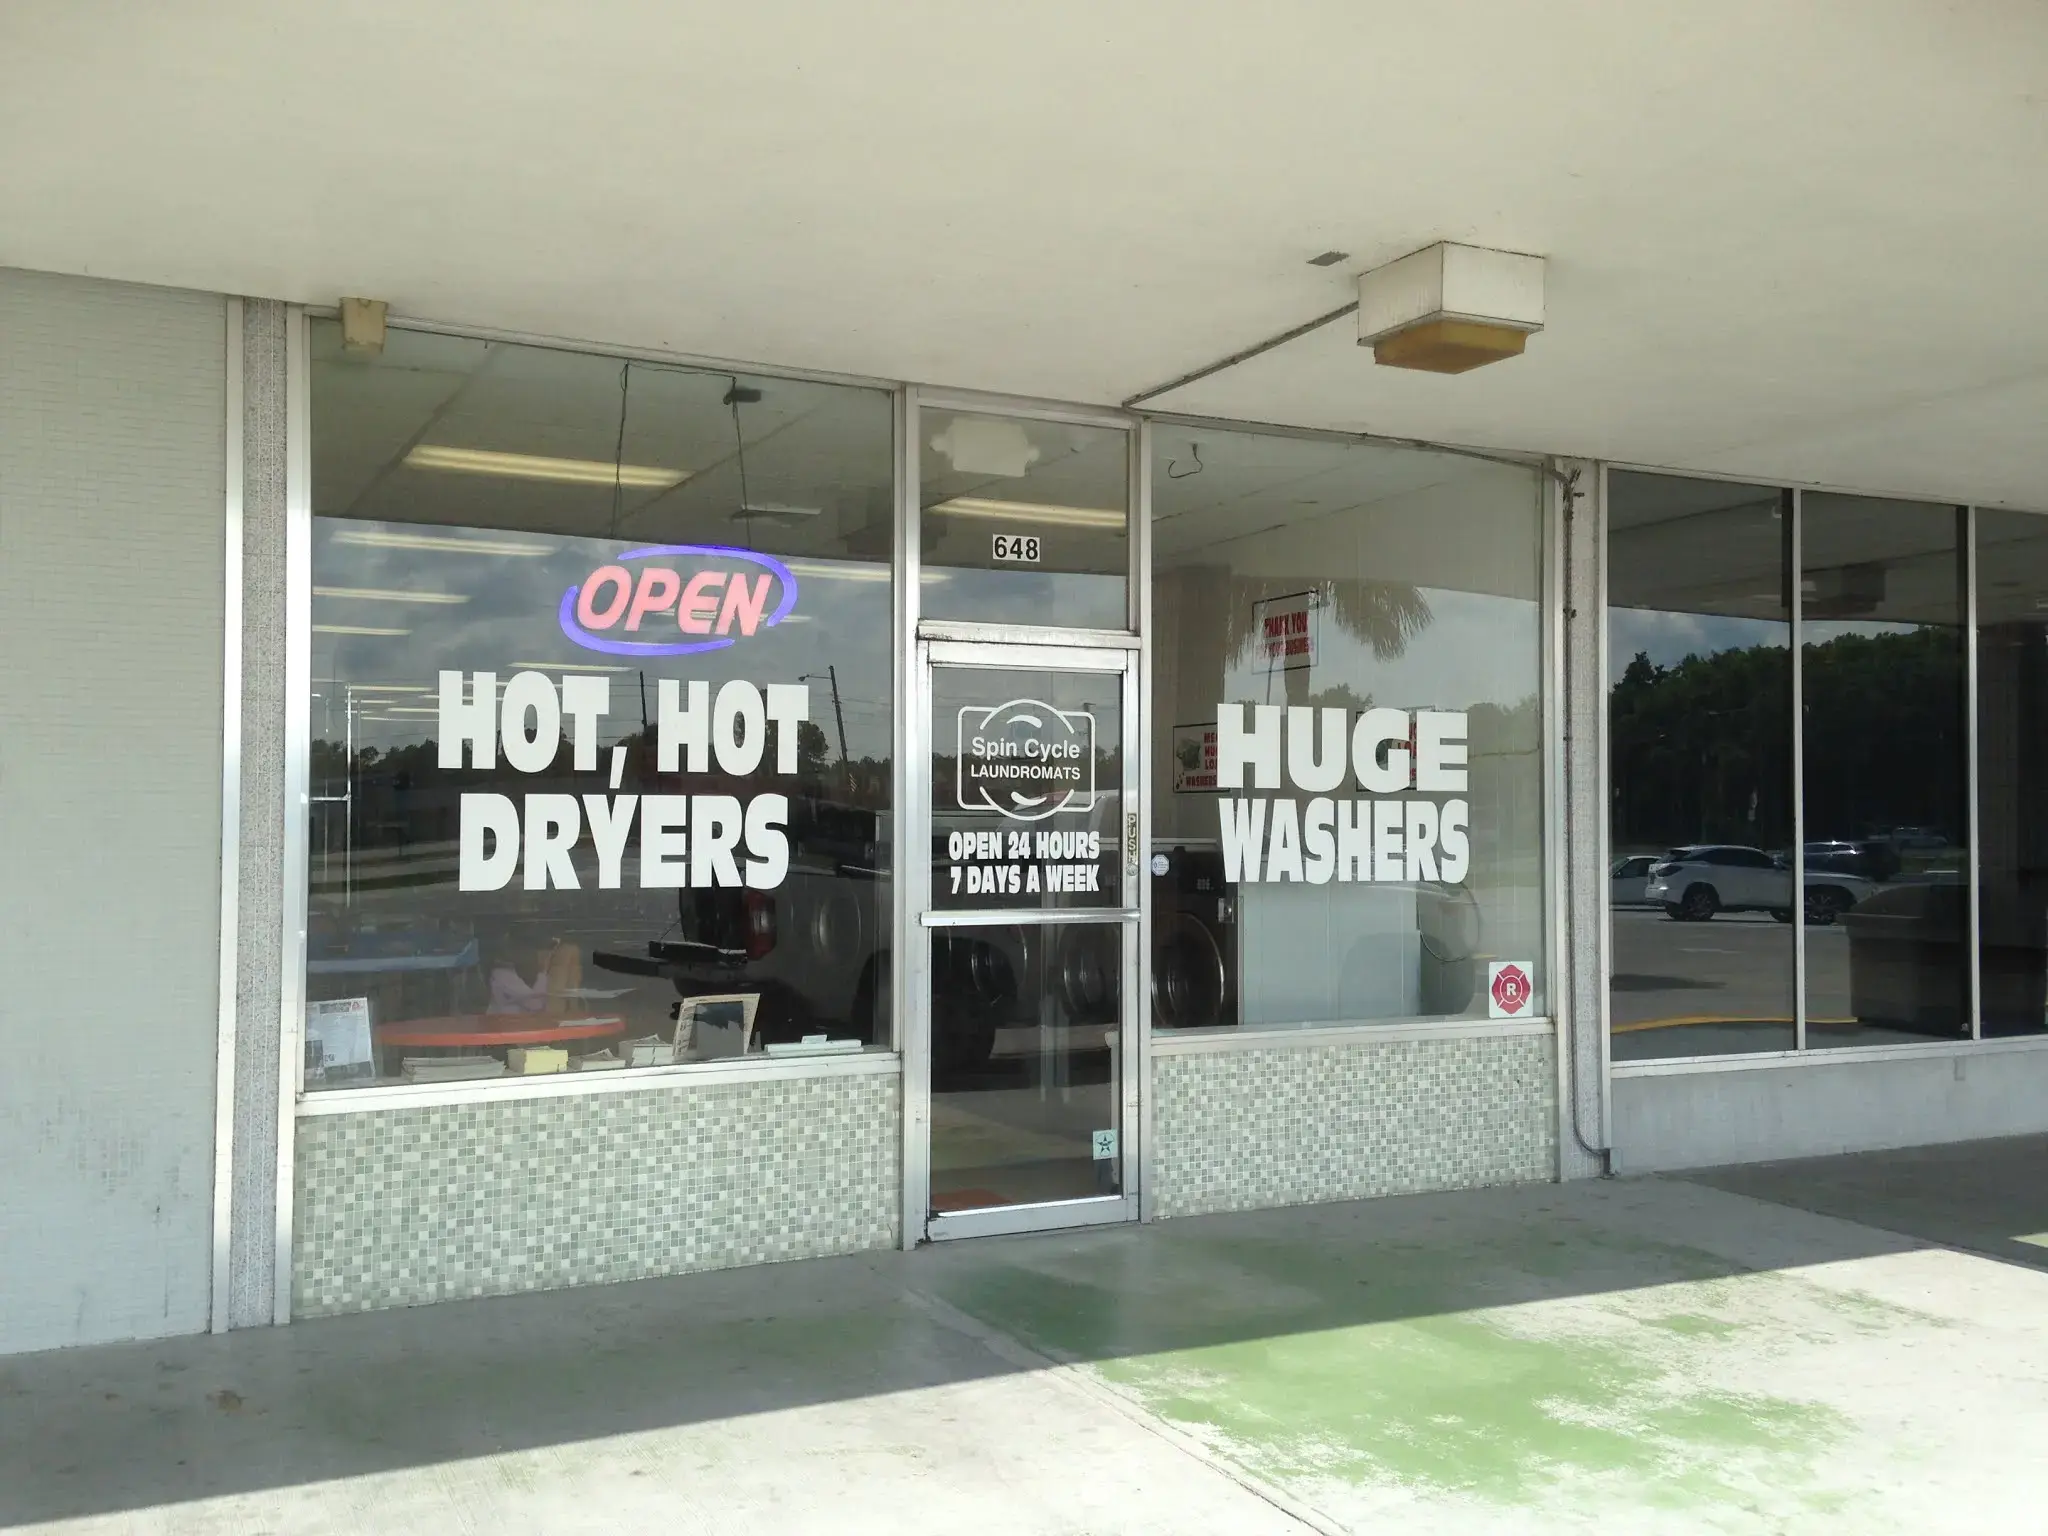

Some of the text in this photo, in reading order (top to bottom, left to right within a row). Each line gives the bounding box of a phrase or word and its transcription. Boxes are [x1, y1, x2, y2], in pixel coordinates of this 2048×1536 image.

[994, 536, 1039, 560] 648
[576, 565, 773, 636] OPEN
[1291, 611, 1309, 634] YOU
[437, 670, 809, 789] HOT, HOT
[972, 736, 1081, 763] Spin Cycle
[1217, 703, 1468, 793] HUGE
[971, 765, 1081, 780] LAUNDROMATS
[459, 792, 789, 892] DRYERS
[948, 831, 1100, 861] OPEN 24 HOURS
[1219, 797, 1470, 885] WASHERS
[950, 864, 1100, 894] 7 DAYS A WEEK
[1506, 983, 1517, 996] R
